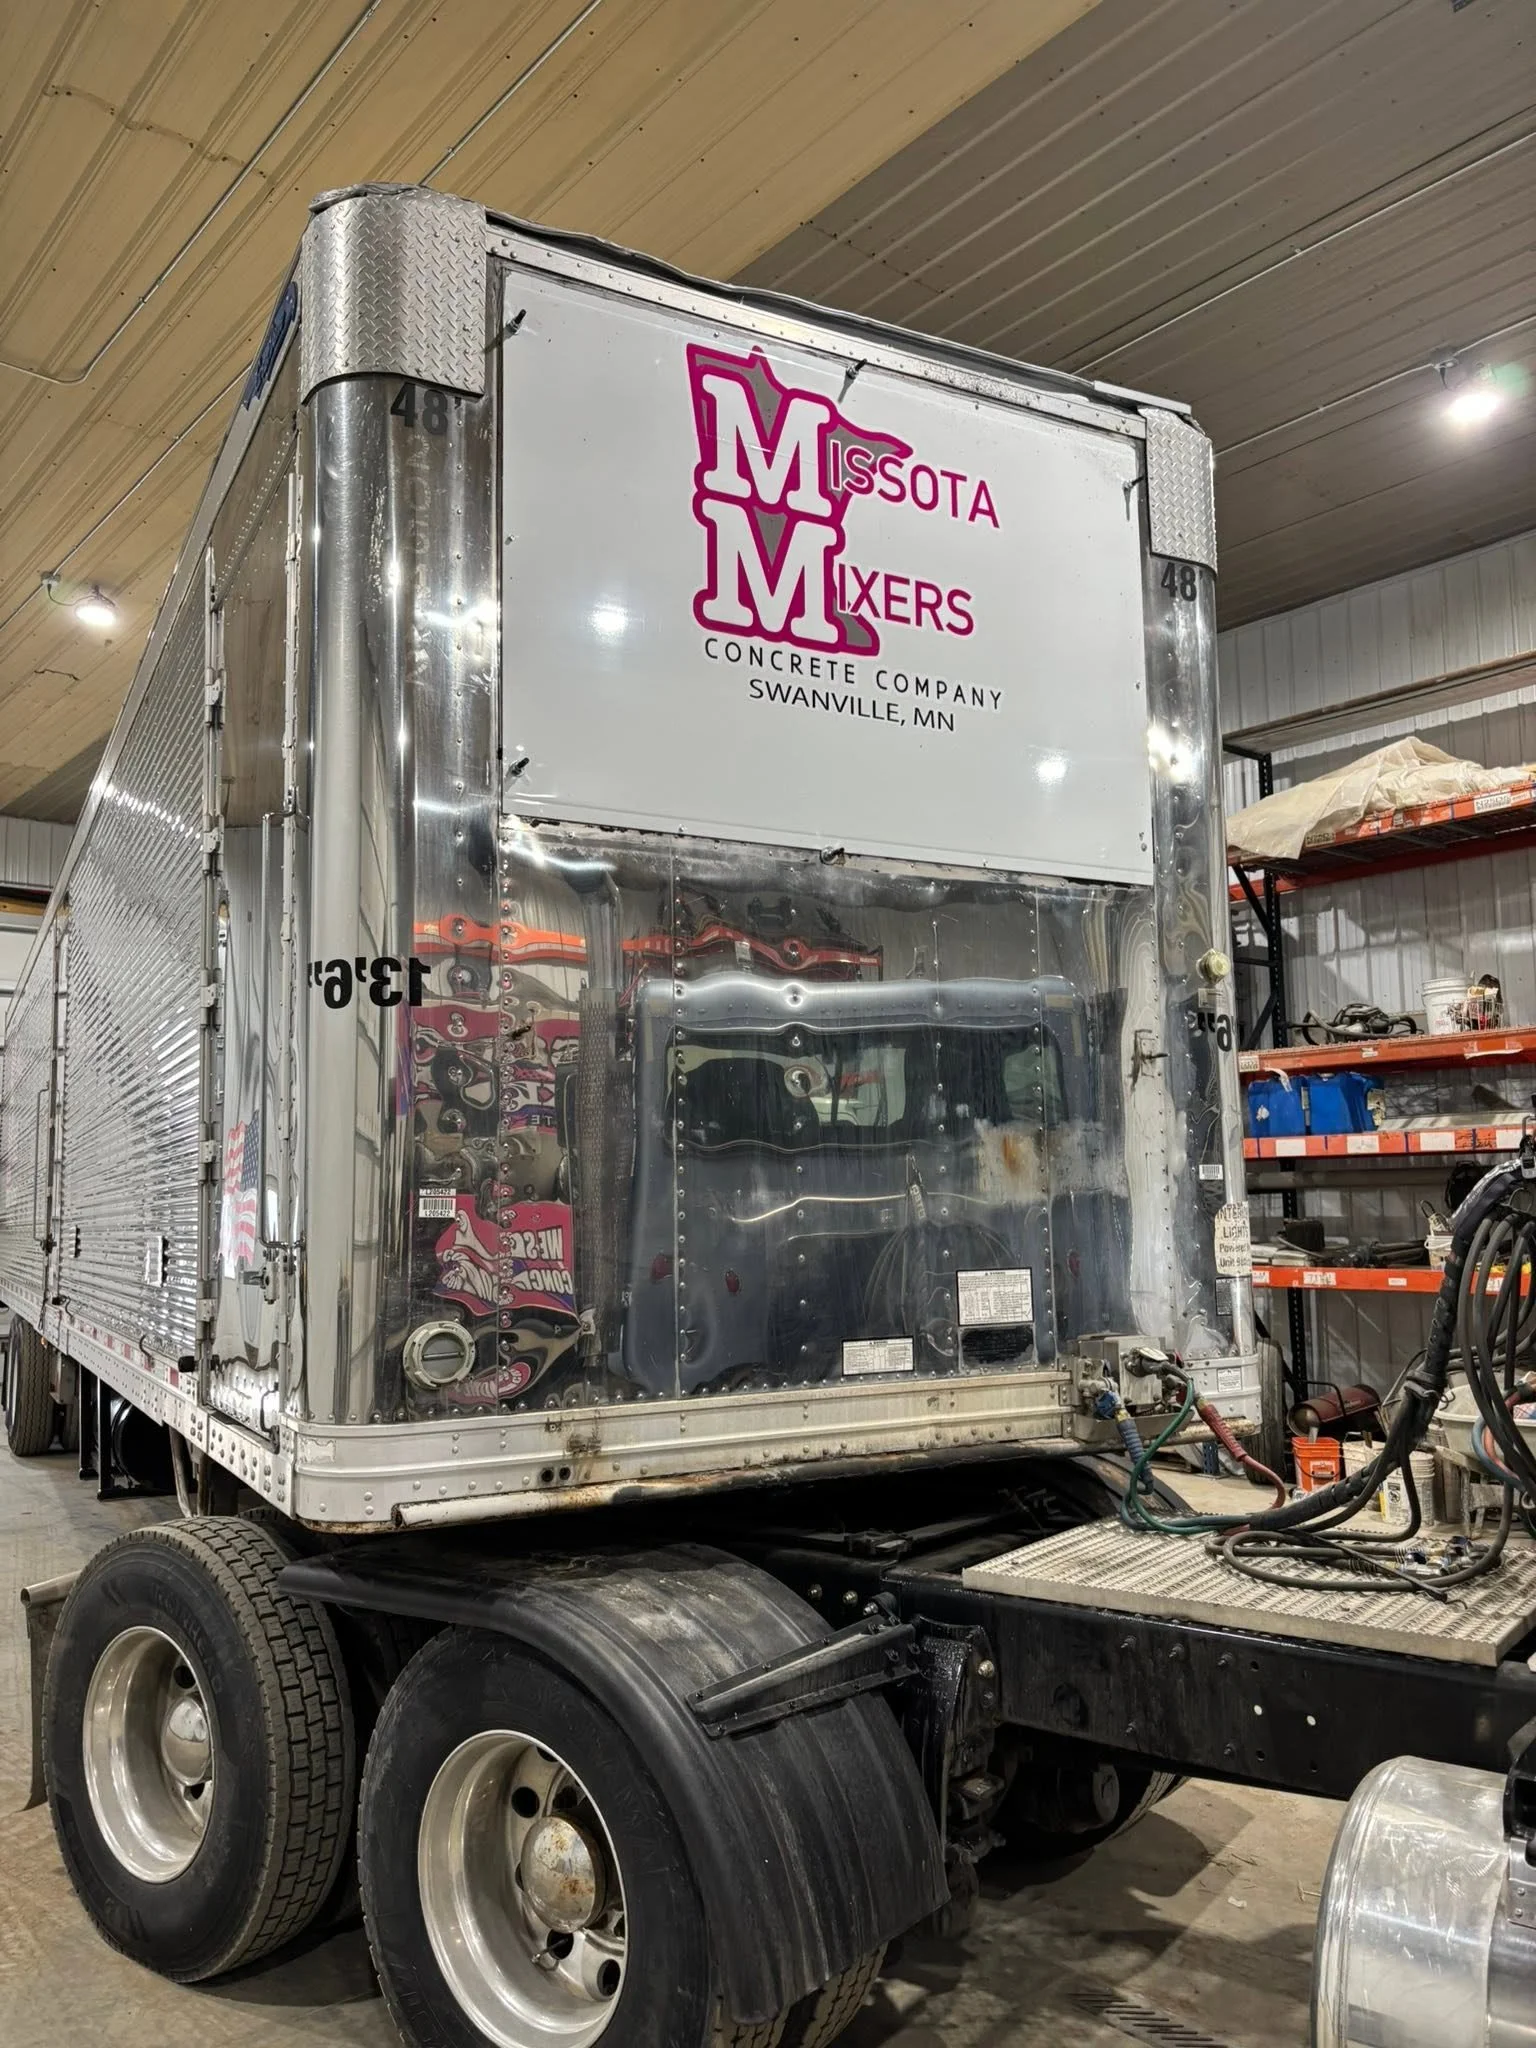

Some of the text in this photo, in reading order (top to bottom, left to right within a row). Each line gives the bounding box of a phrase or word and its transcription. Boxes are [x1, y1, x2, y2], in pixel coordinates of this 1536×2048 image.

[704, 638, 1002, 711] CONCRETE COMPANY
[749, 678, 955, 732] SWANVILLE, MN
